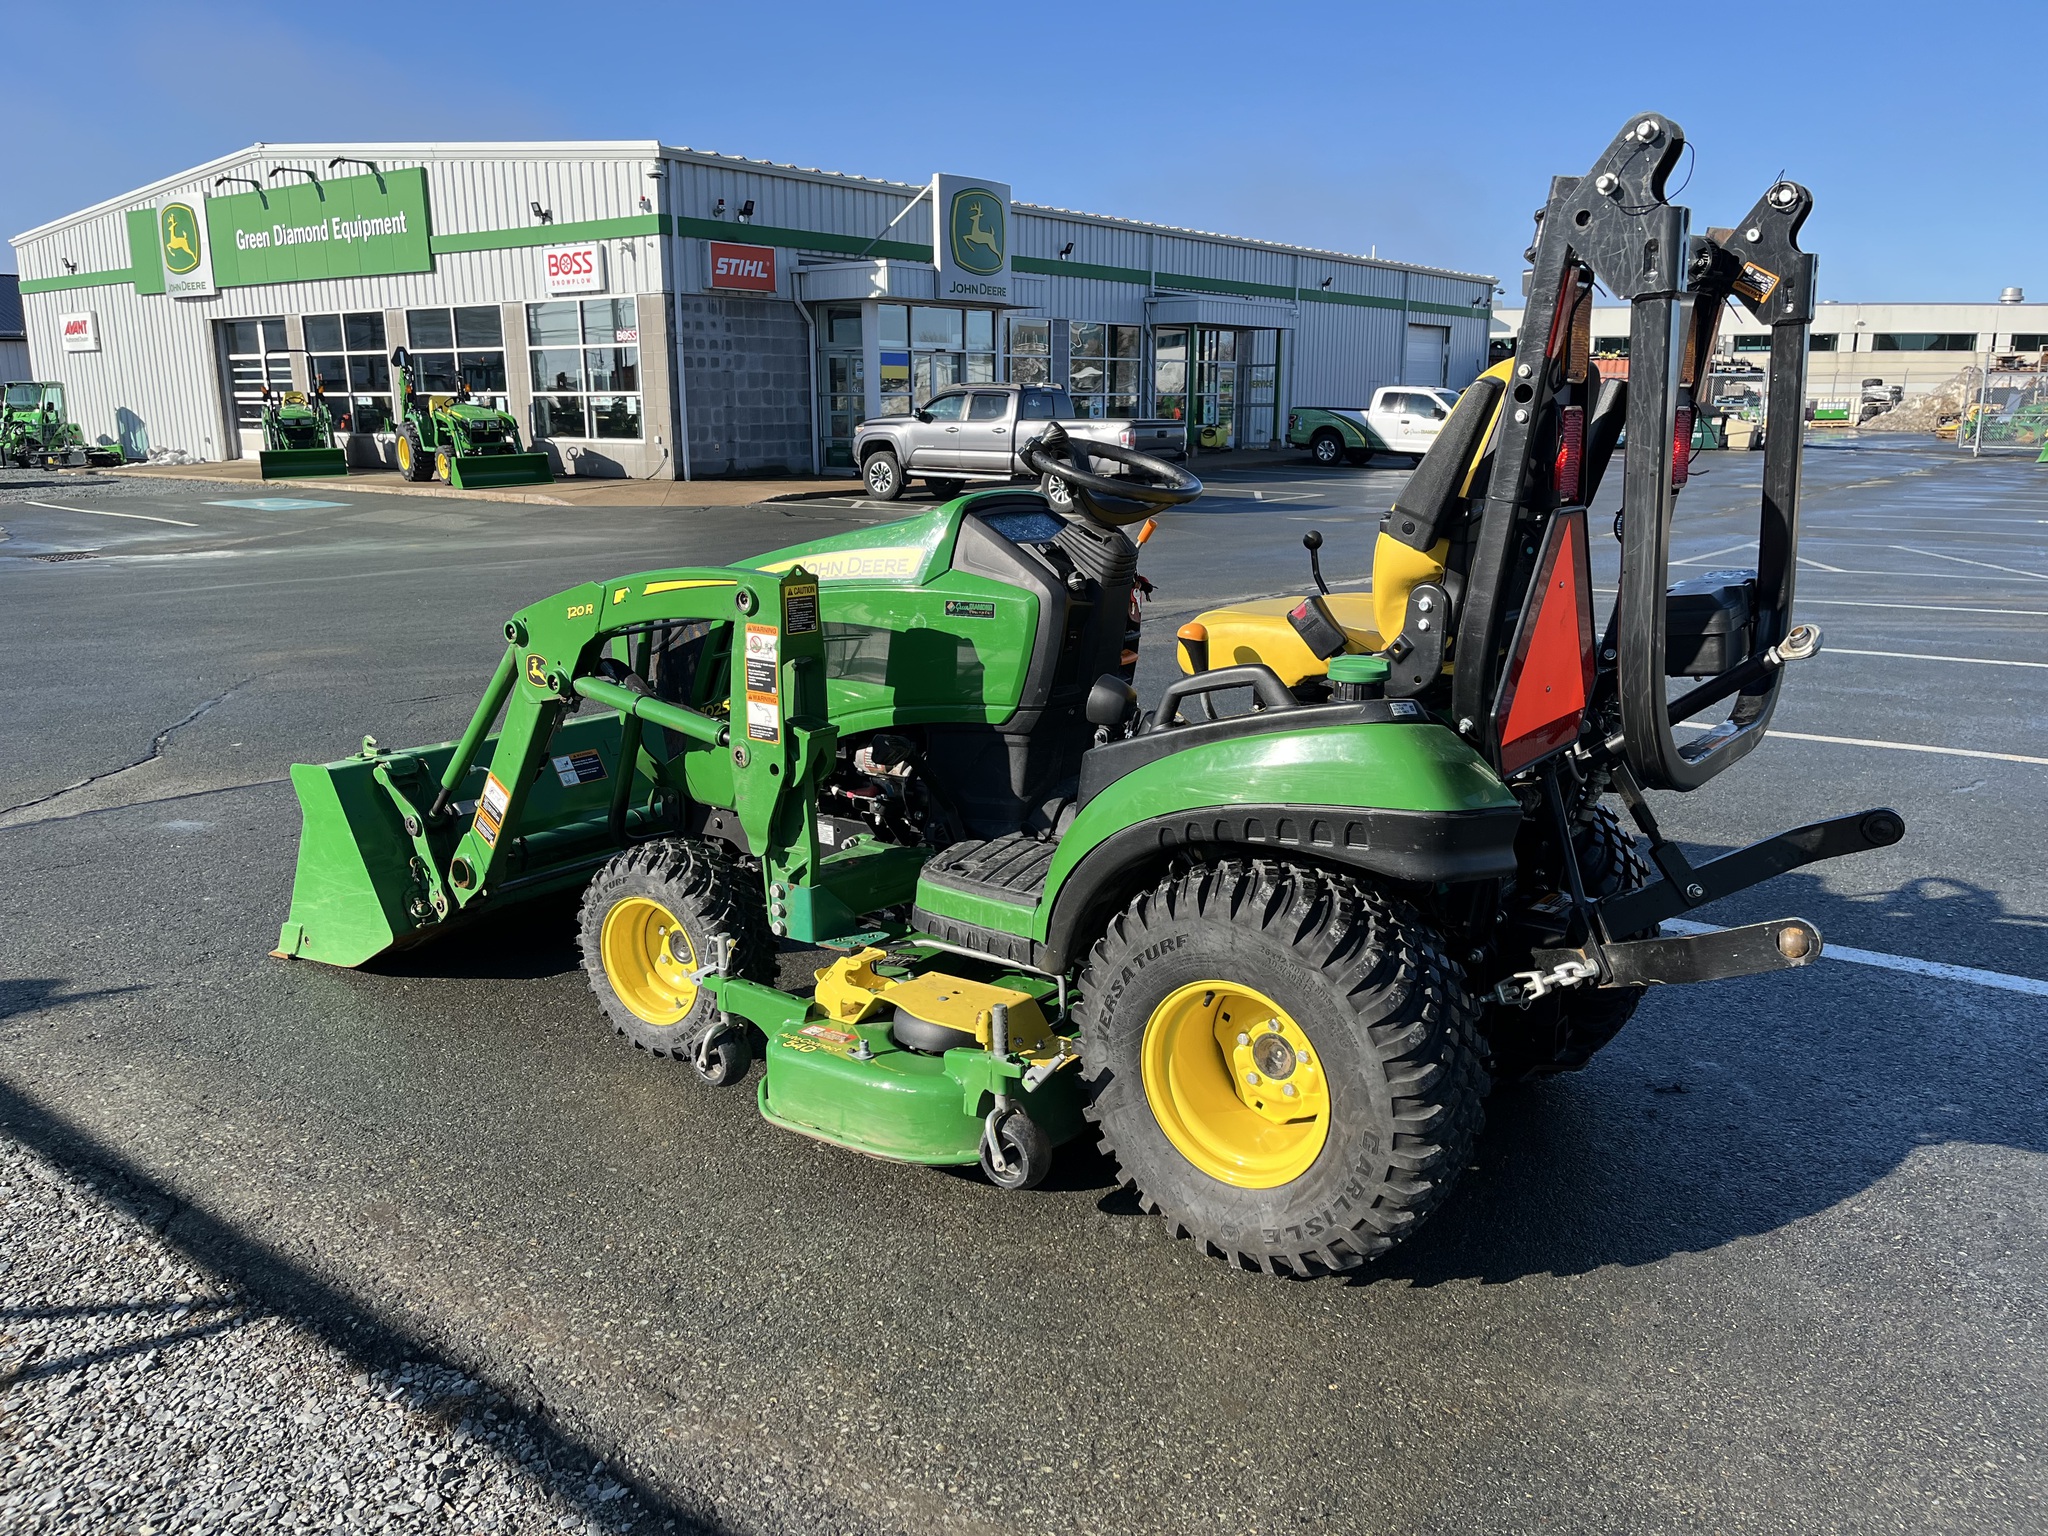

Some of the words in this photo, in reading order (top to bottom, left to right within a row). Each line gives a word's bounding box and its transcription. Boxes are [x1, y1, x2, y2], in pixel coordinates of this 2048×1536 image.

[236, 229, 270, 250] Green
[273, 219, 329, 246] Diamond
[332, 211, 407, 243] Equipment
[548, 251, 593, 277] BOSS
[715, 257, 768, 279] STIHL
[181, 281, 207, 291] DEERE
[552, 278, 591, 286] SNOWPLOW
[949, 281, 978, 294] JOHN
[979, 283, 1007, 297] DEERE
[64, 320, 88, 335] AVANT
[616, 330, 637, 341] BOSS
[847, 557, 909, 574] DEERE
[794, 585, 815, 595] CAUTION
[1096, 965, 1136, 1042] VERSA
[1132, 933, 1189, 970] TURF
[1262, 1130, 1380, 1245] CARLISLE
